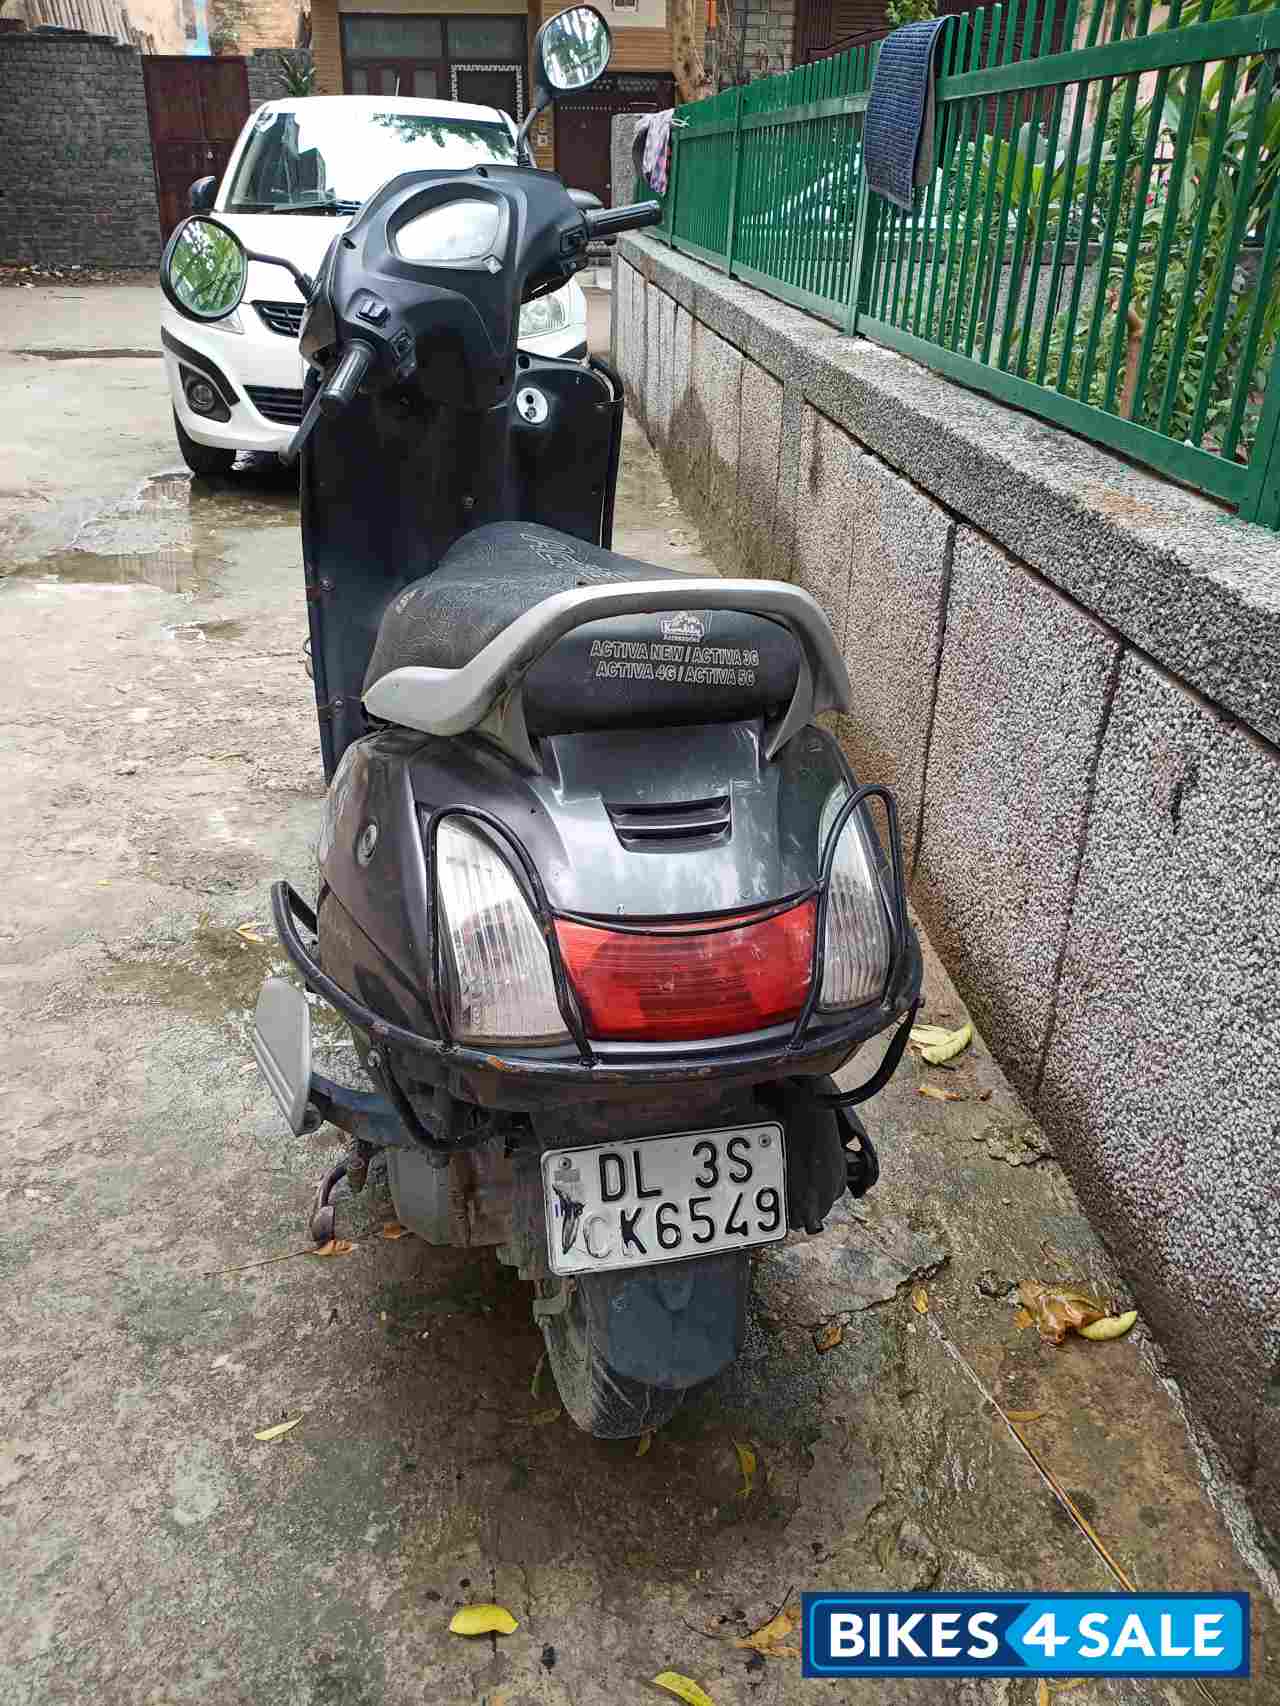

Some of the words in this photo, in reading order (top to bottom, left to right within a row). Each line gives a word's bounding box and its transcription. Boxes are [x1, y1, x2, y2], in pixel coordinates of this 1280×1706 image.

[590, 640, 649, 660] ACTIVA
[651, 646, 684, 662] NEW
[692, 648, 741, 666] ACTIVA
[742, 650, 759, 666] 3G
[595, 661, 654, 680] ACTIVA
[655, 665, 676, 681] 4G
[685, 668, 736, 685] ACTIVA
[598, 1150, 663, 1202] DL
[692, 1137, 753, 1189] 3S
